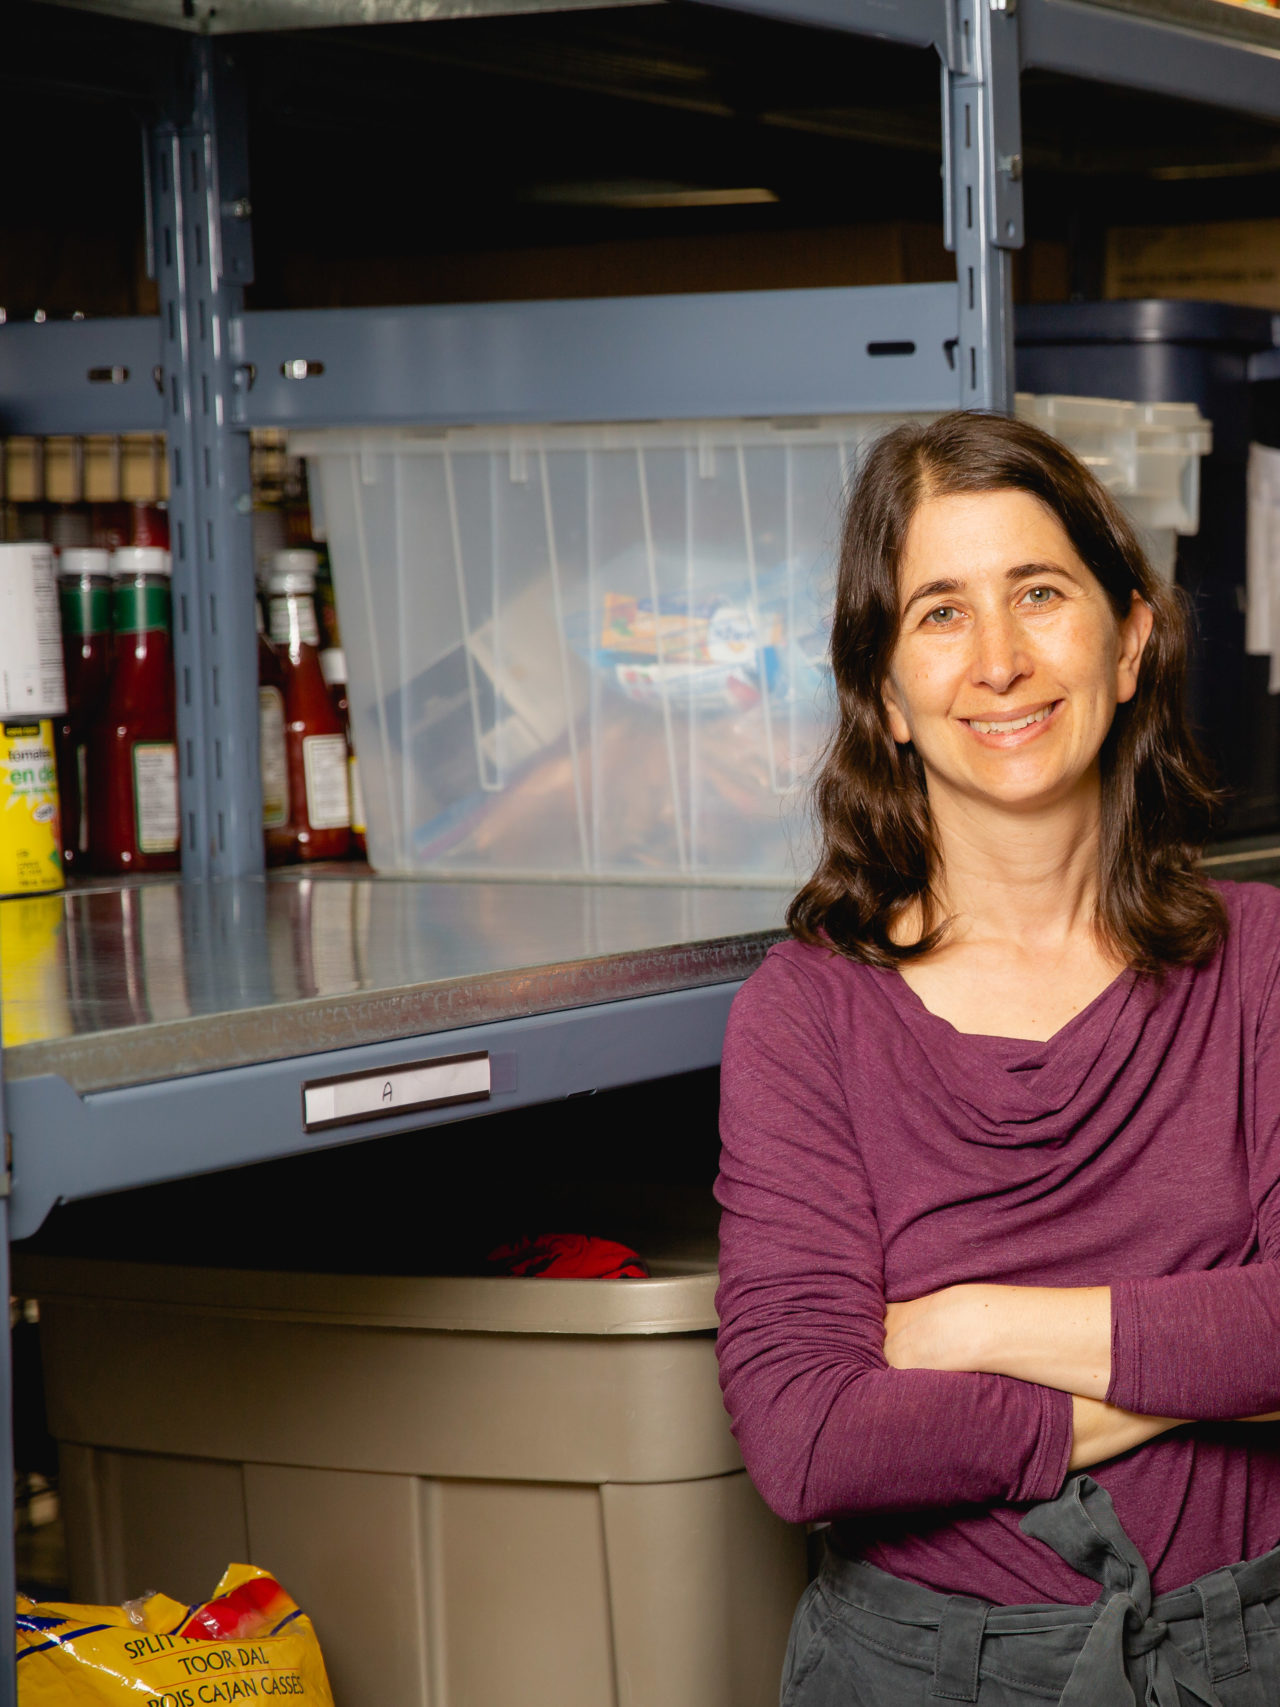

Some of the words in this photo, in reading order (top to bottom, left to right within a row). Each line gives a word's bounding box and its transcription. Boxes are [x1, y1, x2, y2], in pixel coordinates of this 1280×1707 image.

[10, 768, 35, 785] en
[382, 1081, 393, 1102] A
[124, 1633, 174, 1659] SPLIT
[178, 1650, 236, 1675] TOOR
[237, 1647, 269, 1666] DAL
[198, 1678, 258, 1703] CAJAN
[260, 1672, 304, 1696] CASSÉS
